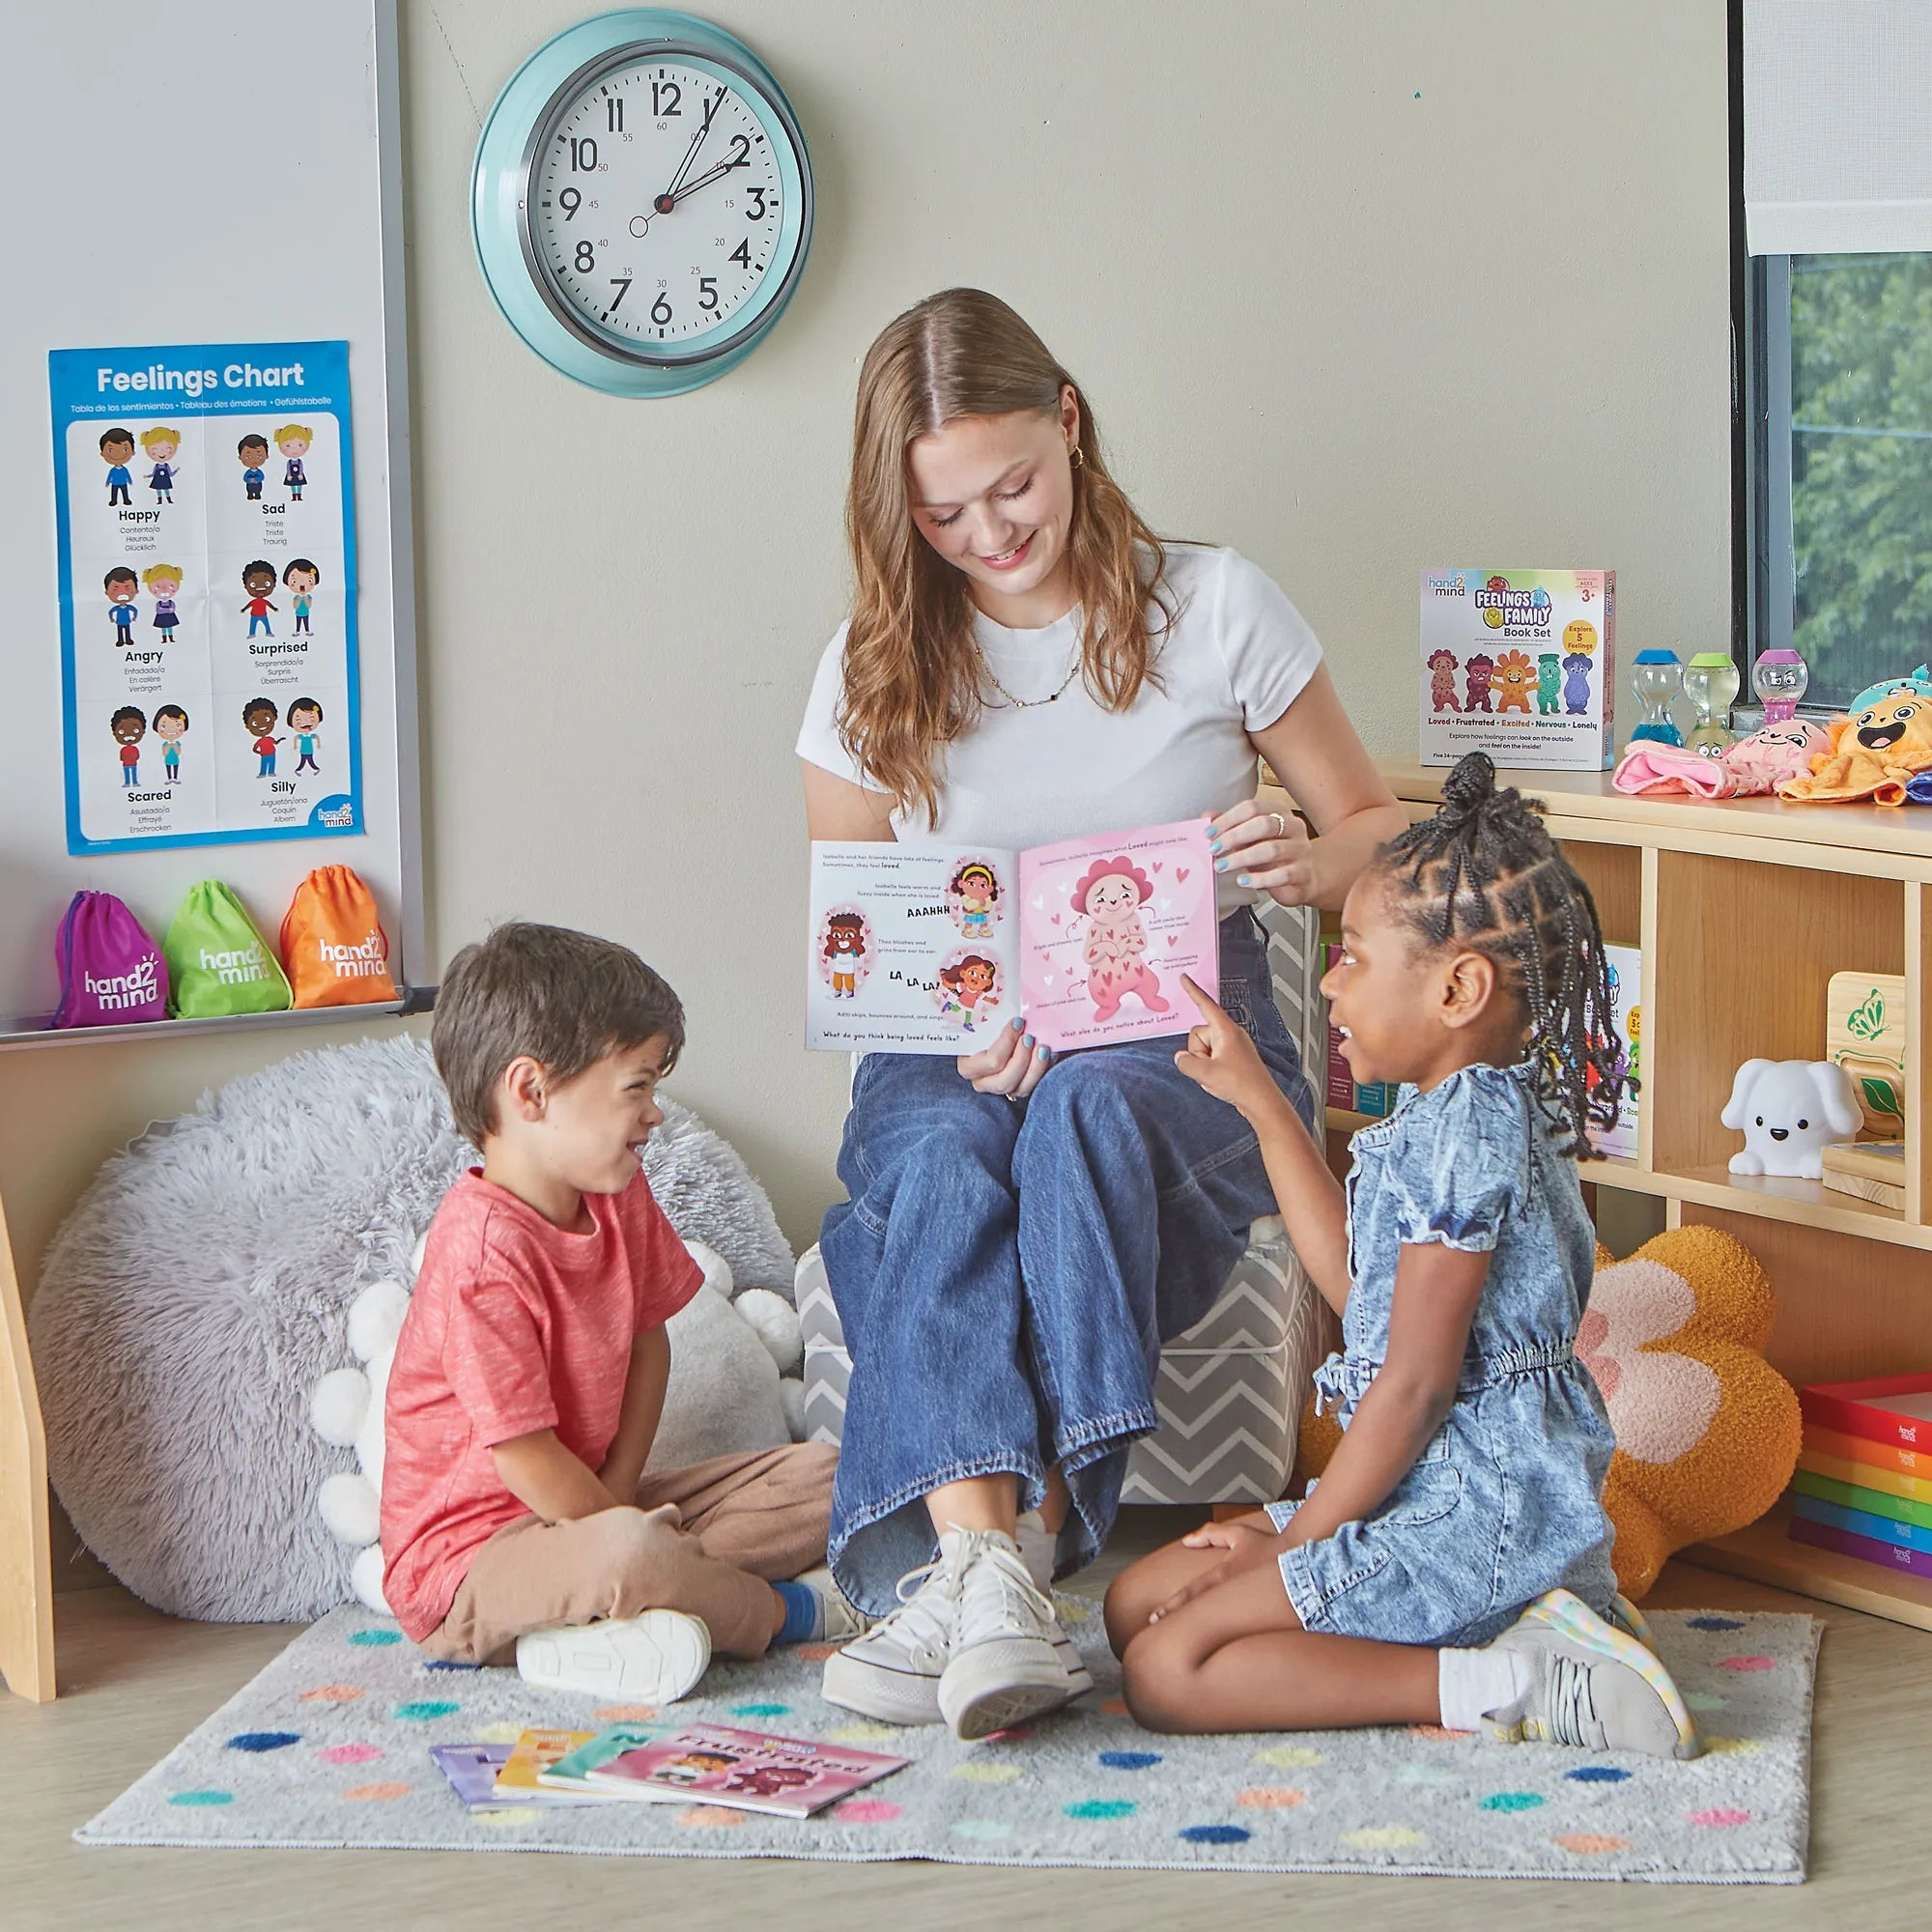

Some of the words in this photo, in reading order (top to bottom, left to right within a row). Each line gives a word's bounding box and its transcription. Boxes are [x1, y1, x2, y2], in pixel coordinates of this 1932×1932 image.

[651, 82, 682, 116] 12
[607, 99, 623, 132] 11
[703, 99, 710, 130] 1
[656, 123, 668, 131] 60
[622, 133, 634, 142] 55
[570, 138, 598, 172] 10
[729, 134, 751, 167] 2
[598, 163, 609, 172] 50
[558, 187, 582, 221] 9
[588, 200, 600, 209] 45
[724, 200, 735, 209] 15
[745, 187, 766, 221] 3
[597, 239, 609, 247] 40
[714, 238, 725, 247] 20
[574, 240, 595, 273] 8
[728, 238, 752, 270] 4
[622, 267, 634, 276] 35
[690, 267, 701, 276] 25
[656, 279, 668, 289] 30
[610, 279, 633, 312] 7
[698, 277, 719, 310] 5
[650, 292, 672, 326] 6
[98, 363, 218, 398] Feelings
[223, 362, 304, 388] Chart
[71, 404, 94, 413] Tabla
[95, 403, 106, 412] de
[107, 402, 120, 412] los
[122, 401, 174, 412] sentimientos
[181, 399, 213, 410] Tableau
[213, 399, 229, 409] des
[230, 397, 268, 408] émotions
[262, 503, 286, 515] Sad
[119, 510, 160, 524] Happy
[120, 525, 160, 534] Contento/a
[125, 543, 156, 552] Glücklich
[263, 537, 288, 547] Traurig
[1429, 576, 1464, 588] hand2
[1435, 585, 1465, 597] mind
[1475, 590, 1532, 609] FEELINGS
[1503, 606, 1552, 626] FAMILY
[1504, 628, 1531, 638] Book
[1533, 628, 1551, 638] Set
[1577, 634, 1583, 642] 5
[249, 641, 308, 658] Surprised
[125, 650, 164, 665] Angry
[268, 668, 292, 677] Surpris
[1456, 718, 1495, 726] Frustrated
[1573, 721, 1598, 731] Lonely
[271, 781, 297, 795] Silly
[128, 789, 172, 803] Scared
[129, 806, 170, 815] Asustado/a
[271, 807, 297, 815] Coquin
[326, 816, 353, 827] mind
[129, 824, 172, 834] Erschrocken
[319, 934, 384, 962] hand2
[218, 962, 270, 985] mind
[336, 958, 386, 978] mind
[85, 960, 157, 994] hand2
[890, 971, 902, 980] LA
[906, 978, 920, 986] LA
[923, 981, 940, 991] LA!
[99, 982, 158, 1010] mind
[887, 1033, 904, 1042] being
[677, 1735, 870, 1773] Frustrated
